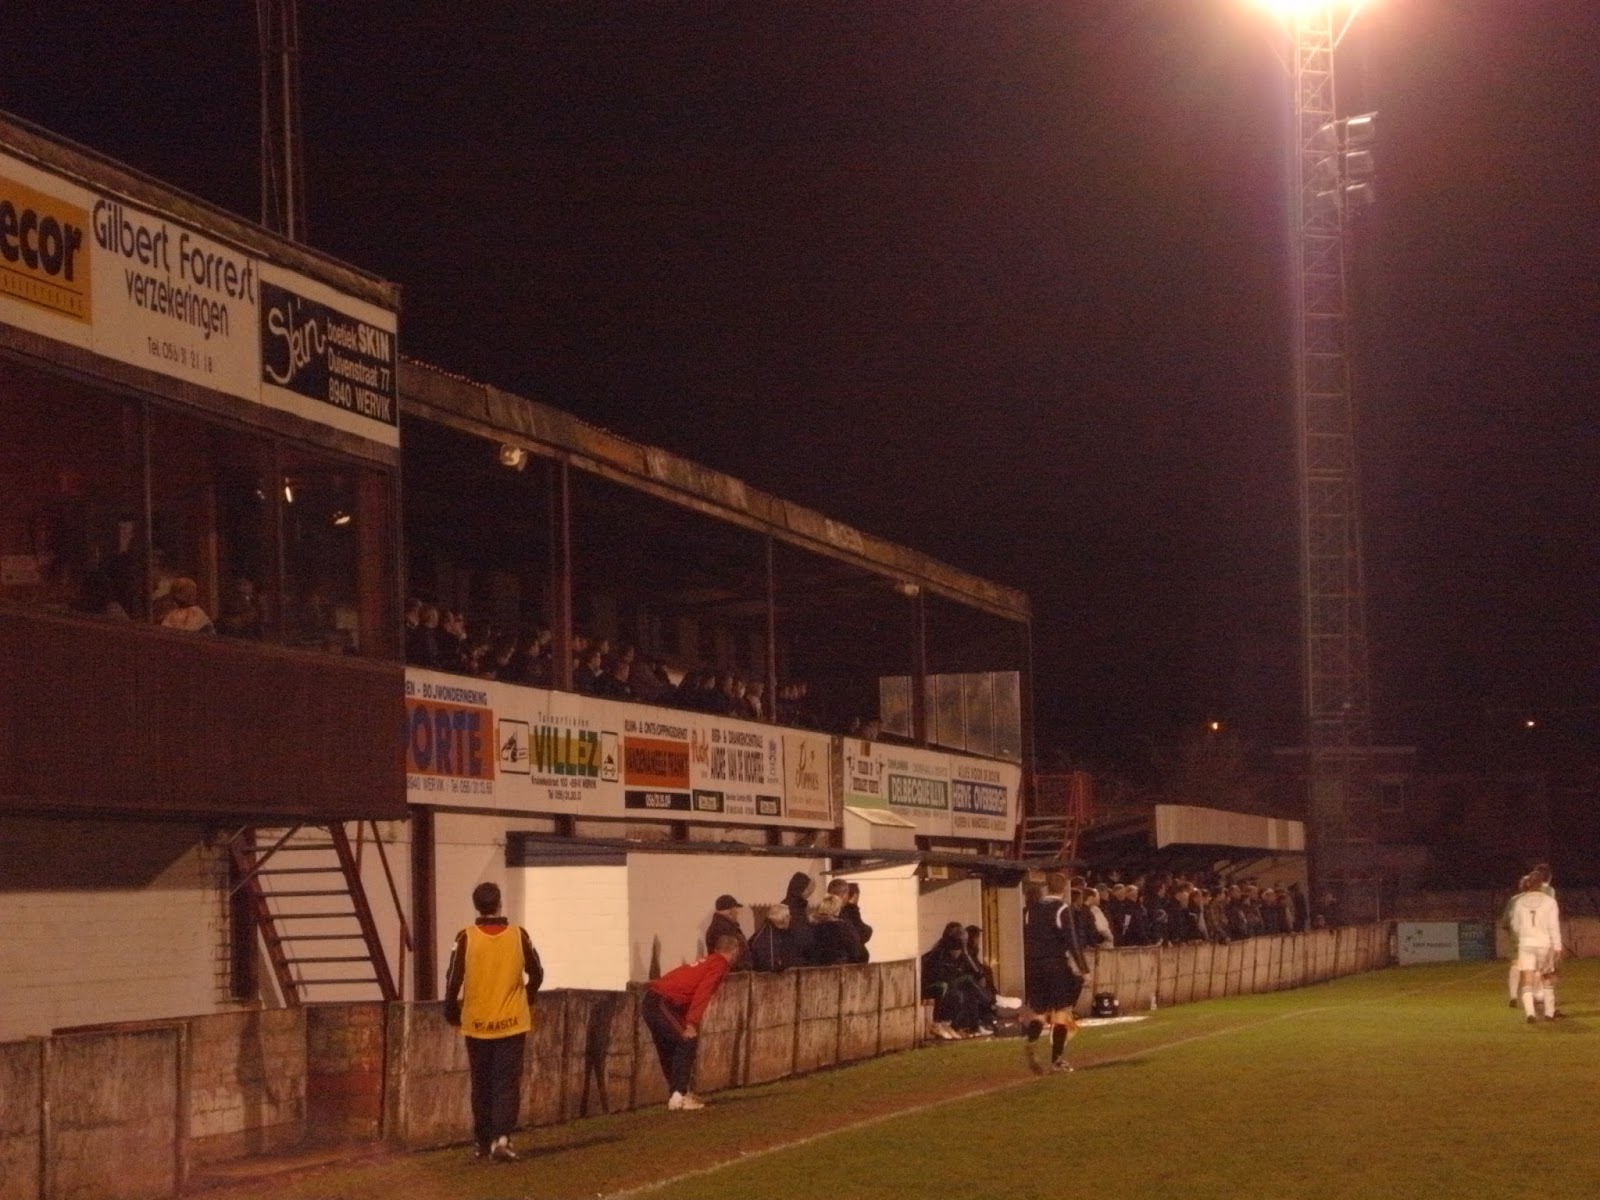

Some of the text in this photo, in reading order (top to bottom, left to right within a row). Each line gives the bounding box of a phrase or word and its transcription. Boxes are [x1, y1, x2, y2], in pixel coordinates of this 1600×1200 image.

[93, 199, 255, 304] Gilbert Forrest
[124, 268, 230, 341] verzekeringen
[357, 323, 390, 363] SKIN
[328, 377, 391, 422] 8940 WERVIK
[380, 367, 390, 392] 77
[534, 725, 598, 777] VILLEZ
[487, 1016, 518, 1031] MASITA
